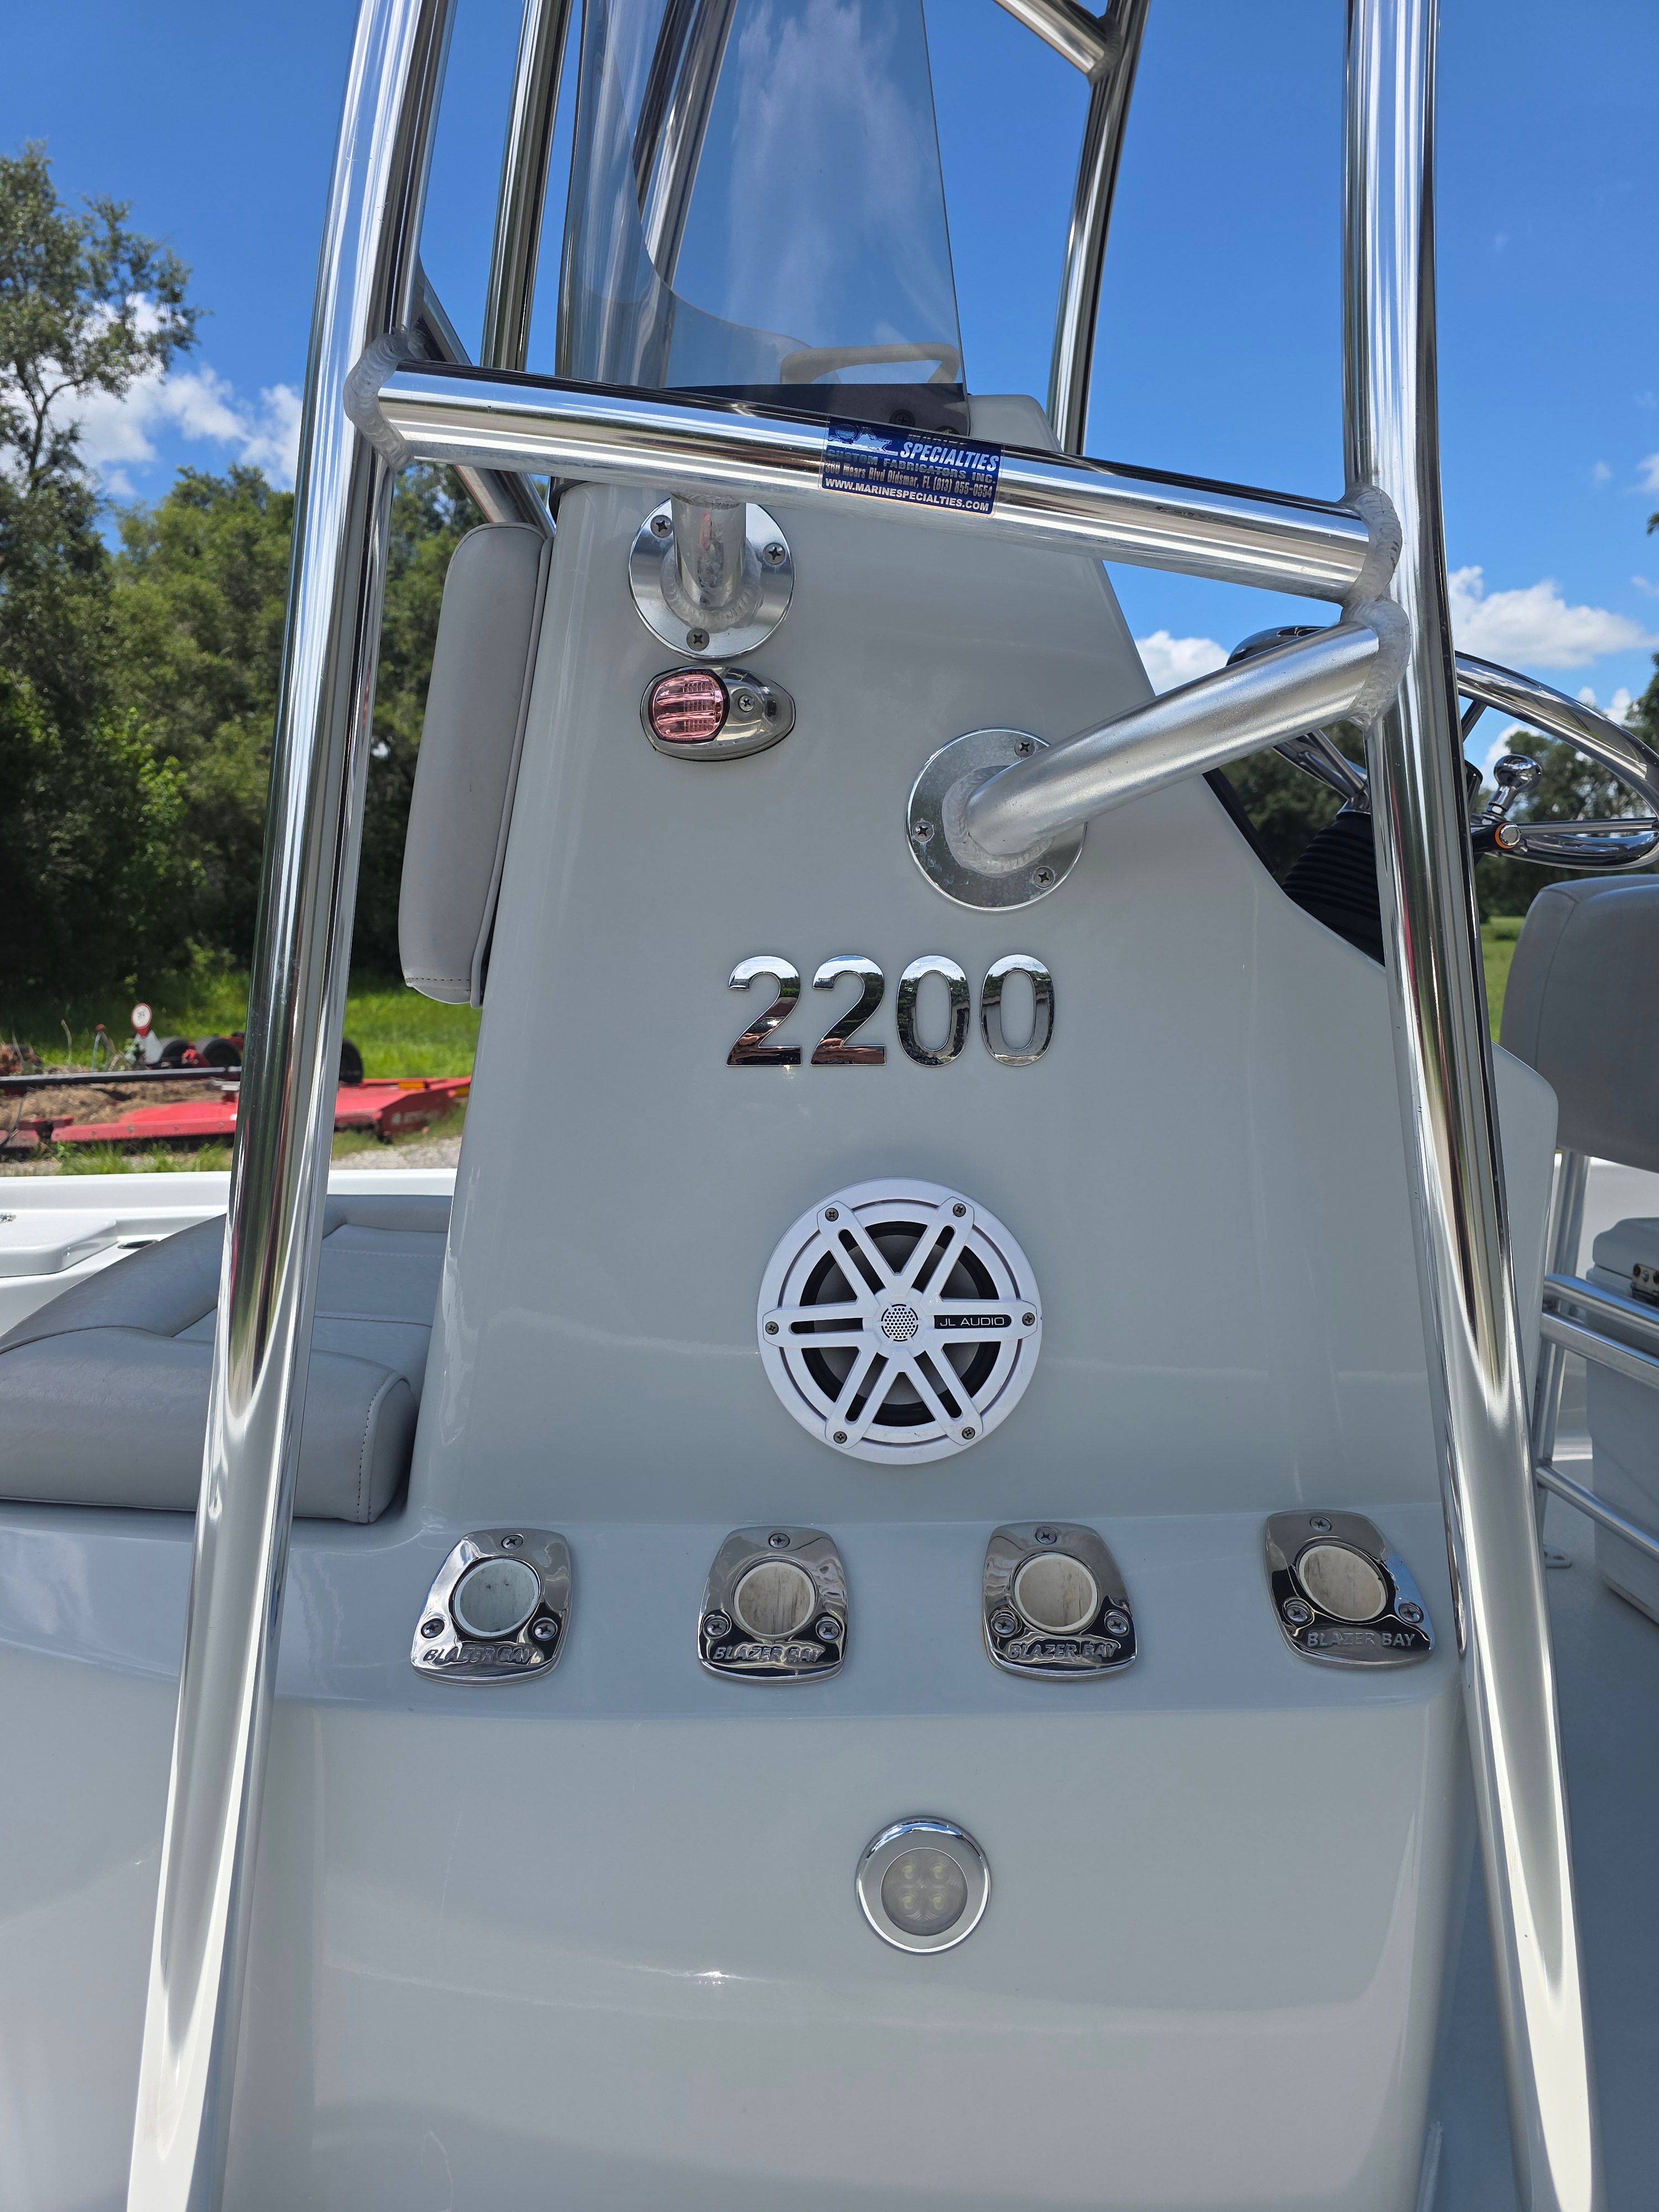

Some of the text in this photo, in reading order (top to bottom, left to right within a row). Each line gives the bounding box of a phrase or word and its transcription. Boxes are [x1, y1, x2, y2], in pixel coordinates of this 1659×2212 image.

[827, 450, 996, 484] CUSTOM FABRICATORS INC.
[900, 442, 999, 472] SPECIALTIES
[842, 463, 866, 479] Mears
[868, 467, 886, 482] Blvd
[887, 470, 919, 489] Oldsmar,
[922, 476, 930, 489] FL
[933, 476, 953, 493] (813)
[954, 481, 993, 499] 855-0554
[825, 478, 989, 512] WWW.MARINESPECIALTIES.COM
[726, 954, 1055, 1066] 2200
[940, 1317, 1005, 1326] JL AUDIO
[1009, 1644, 1118, 1658] BLAZER BAY
[1307, 1632, 1416, 1647] BLAZER BAY
[423, 1646, 495, 1664] BLAZER
[713, 1646, 823, 1662] BLAZER BAY
